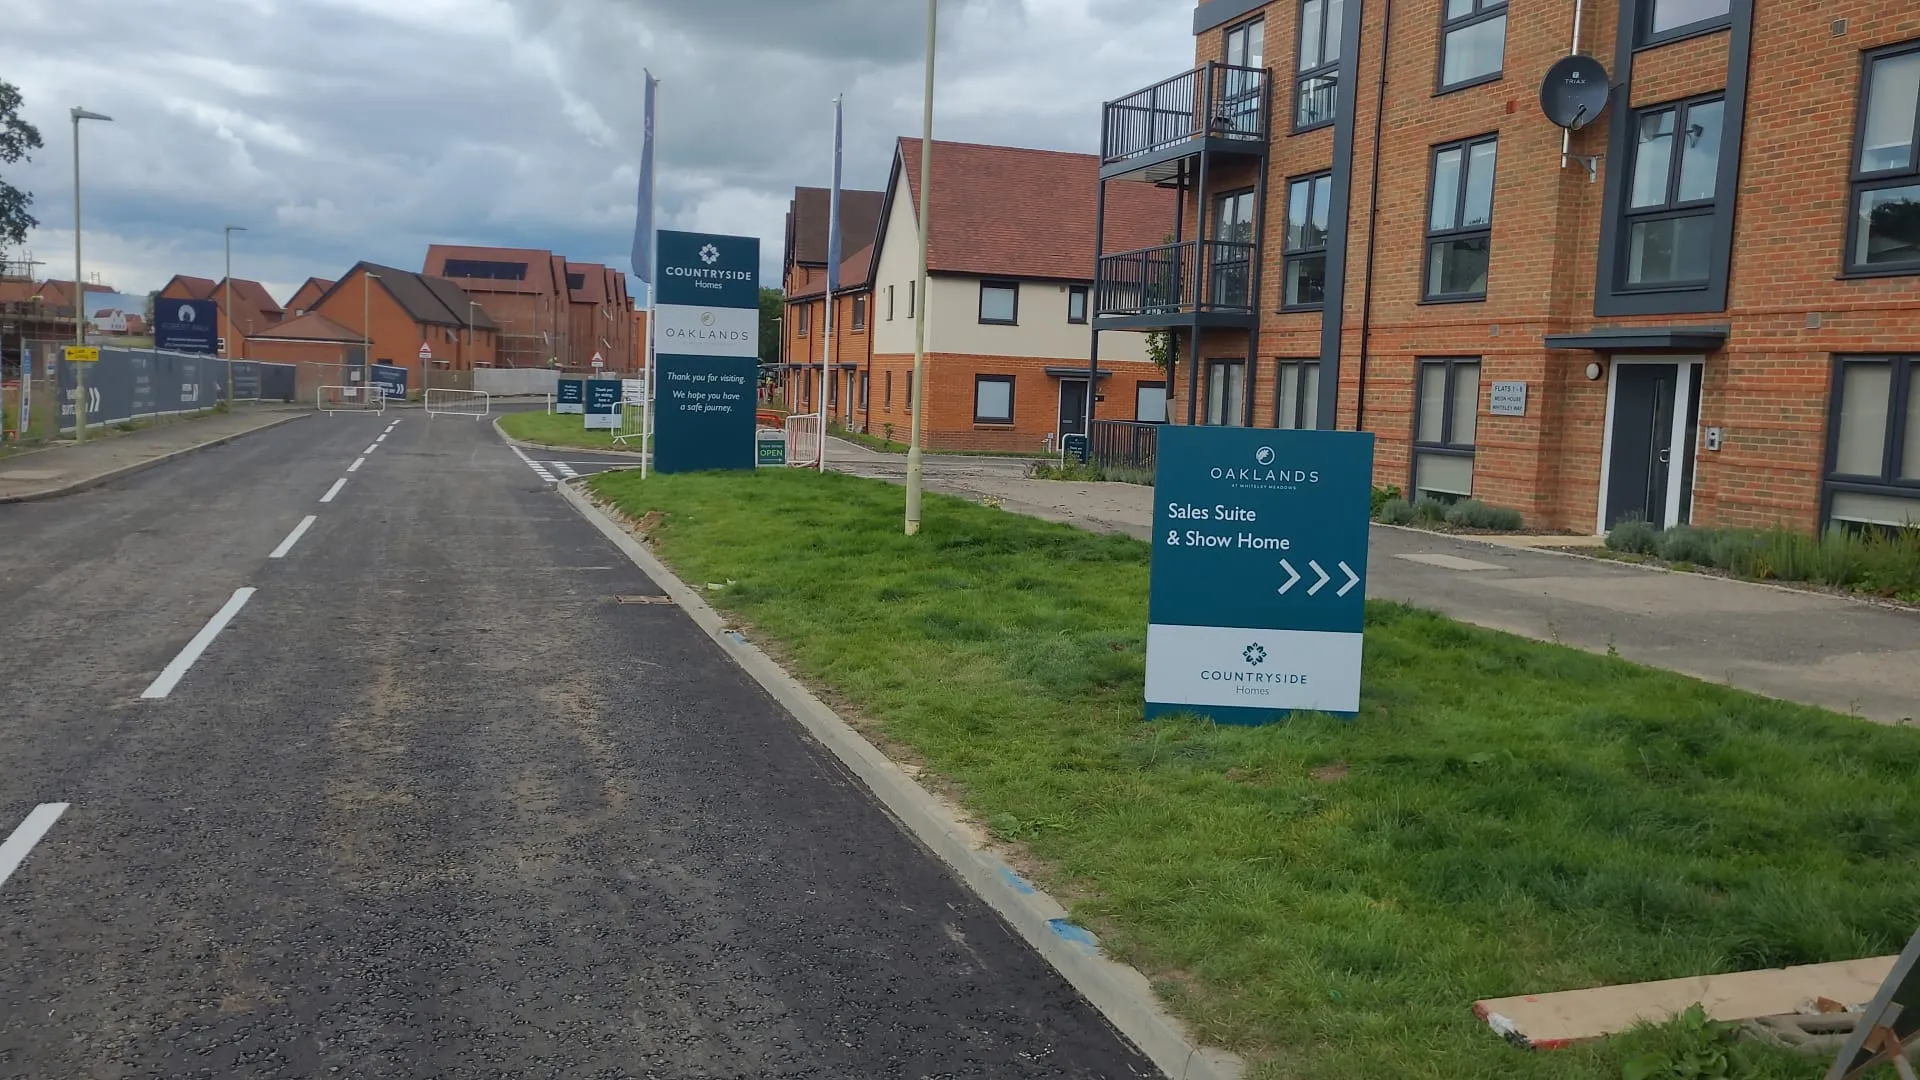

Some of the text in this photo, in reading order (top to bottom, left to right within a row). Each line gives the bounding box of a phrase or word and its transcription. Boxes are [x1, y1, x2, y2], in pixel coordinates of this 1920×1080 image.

[665, 266, 752, 281] COUNTRYSIDE
[695, 280, 722, 289] Homes
[665, 328, 749, 341] OAKLANDS
[667, 371, 746, 384] Thank you for visiting.
[672, 390, 740, 402] We hope you have
[687, 402, 703, 412] safe
[704, 403, 733, 413] journey.
[760, 449, 783, 457] OPEN
[1210, 467, 1319, 483] OAKLANDS
[1168, 502, 1256, 522] Sales Suite
[1167, 530, 1290, 550] & Show Home
[1200, 670, 1307, 685] COUNTRYSIDE
[1236, 685, 1270, 696] Homes
